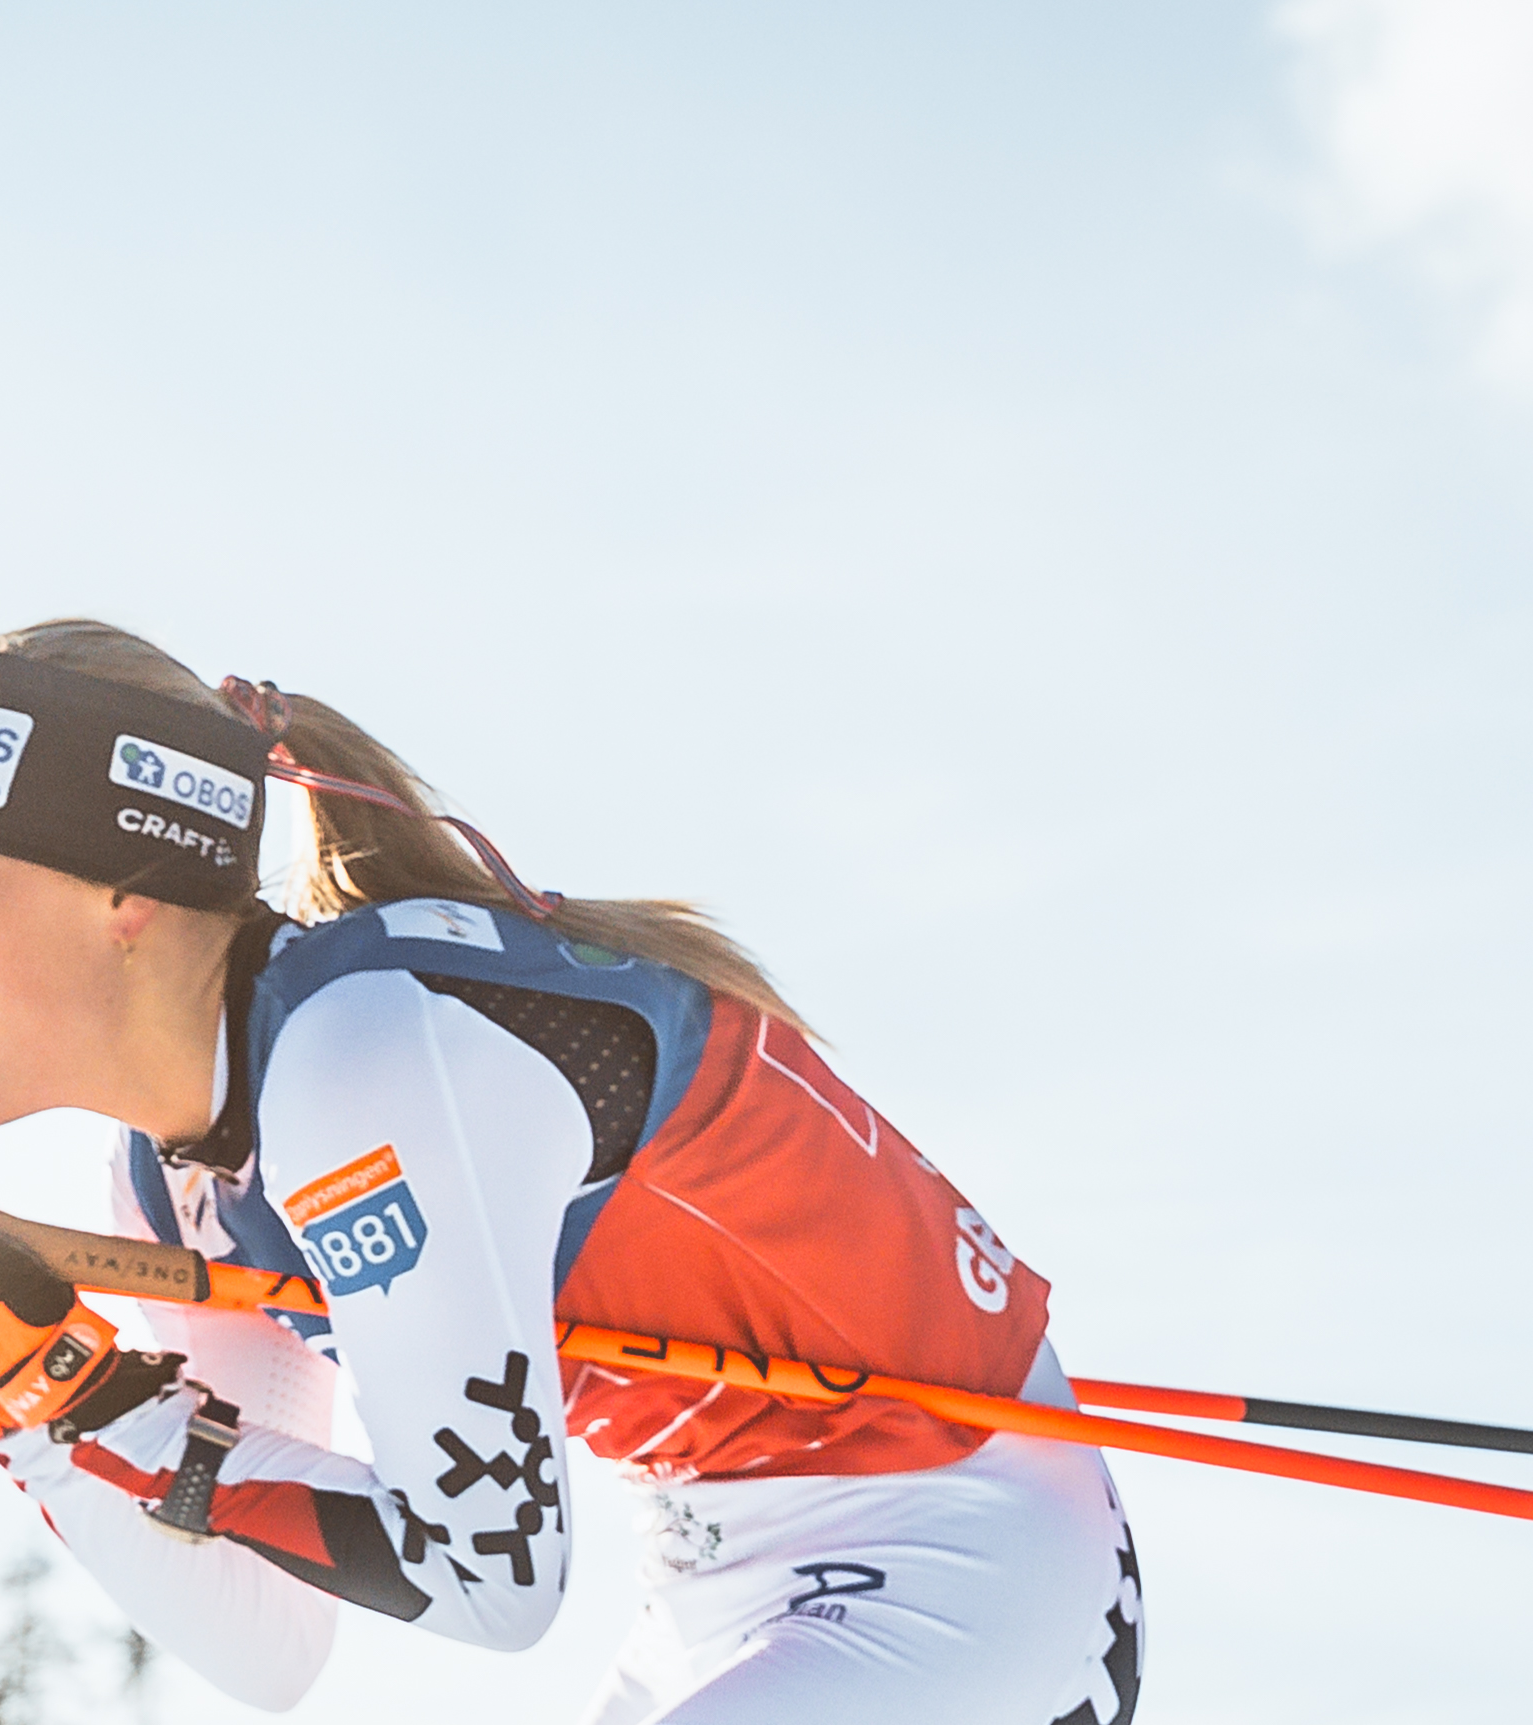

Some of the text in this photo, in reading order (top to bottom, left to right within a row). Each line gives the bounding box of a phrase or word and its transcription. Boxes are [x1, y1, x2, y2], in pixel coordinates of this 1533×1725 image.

[173, 771, 248, 822] OBOS
[117, 808, 215, 857] CRAFT
[304, 1201, 419, 1281] 1881
